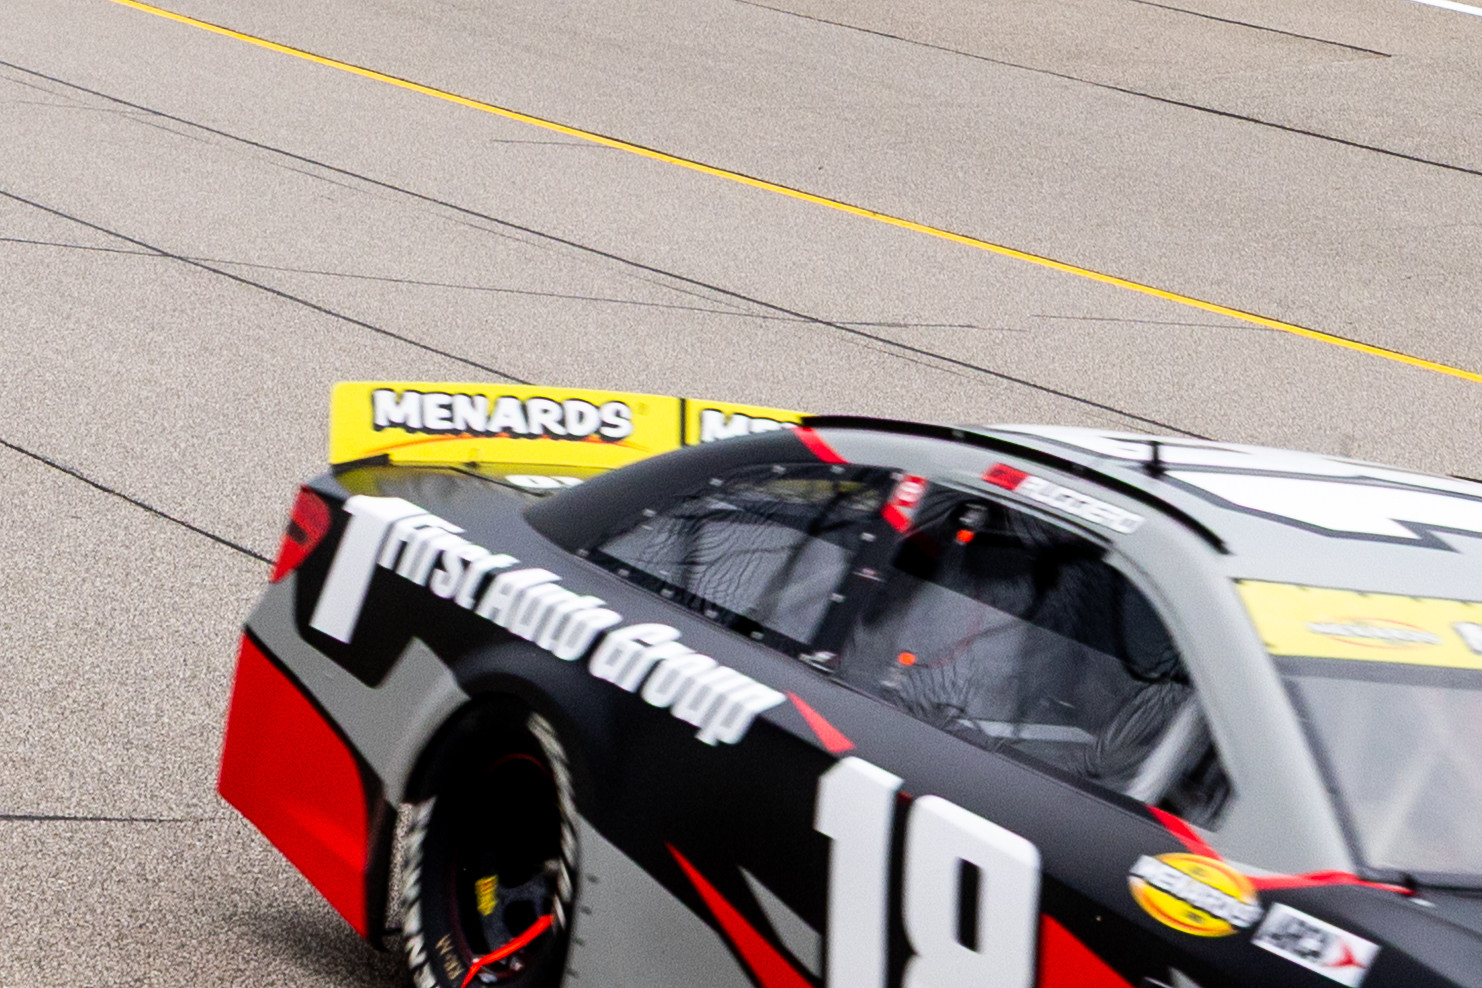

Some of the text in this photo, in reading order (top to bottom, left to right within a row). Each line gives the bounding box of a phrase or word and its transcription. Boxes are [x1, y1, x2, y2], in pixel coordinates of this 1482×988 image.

[372, 388, 633, 441] MENARDS
[377, 499, 519, 612] First
[477, 567, 622, 661] Auto
[589, 620, 789, 747] Group
